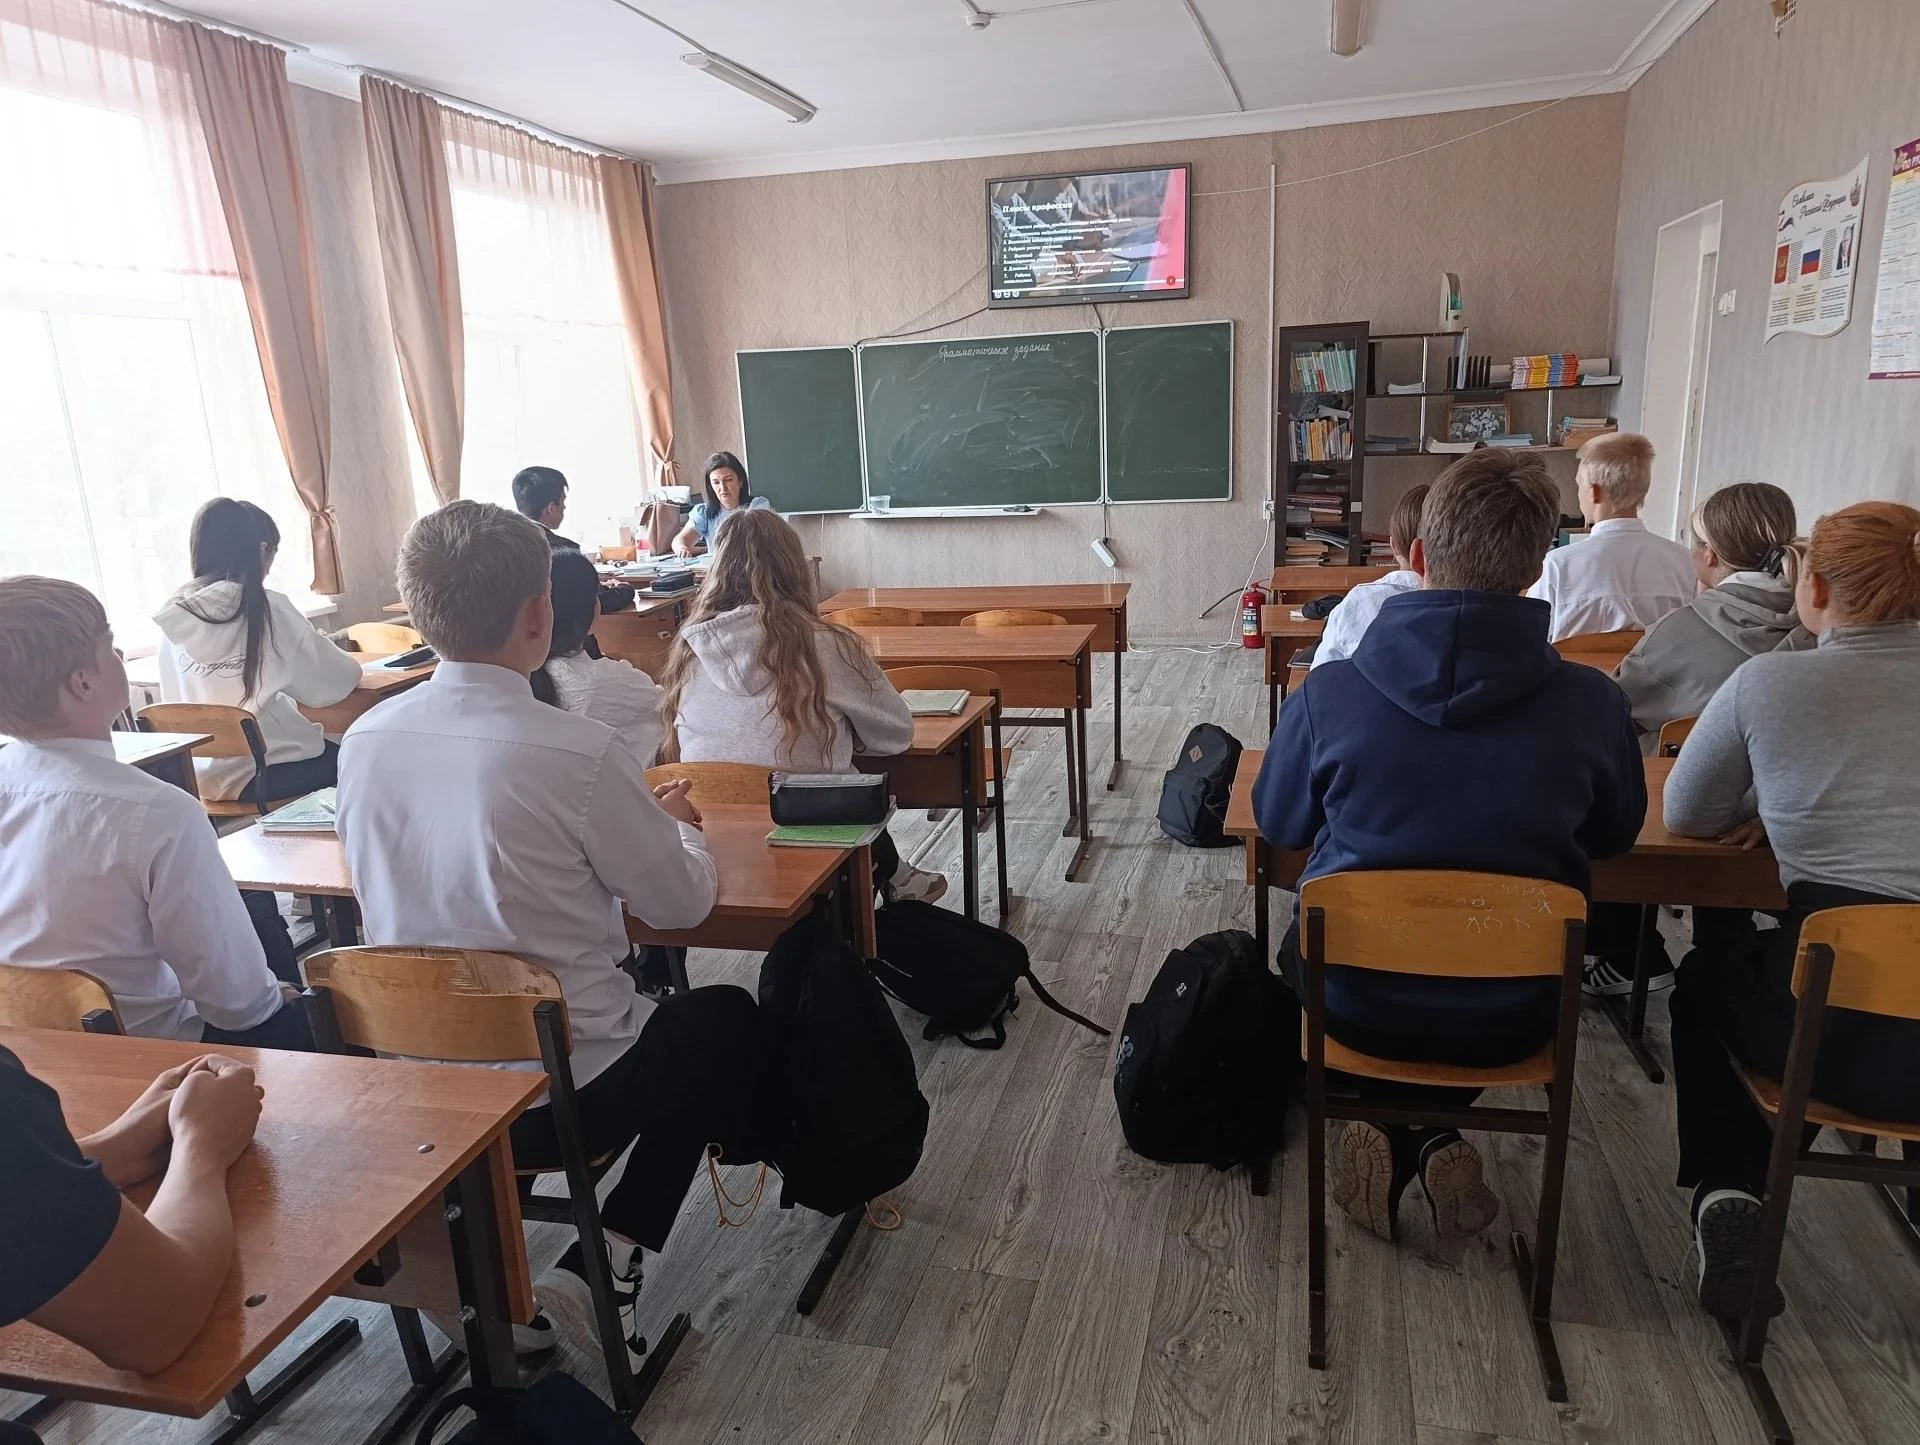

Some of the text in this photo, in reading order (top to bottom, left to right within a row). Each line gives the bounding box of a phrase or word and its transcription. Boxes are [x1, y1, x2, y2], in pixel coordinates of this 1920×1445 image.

[1003, 202, 1073, 213] Плюсы профессии
[1013, 343, 1051, 361] задание
